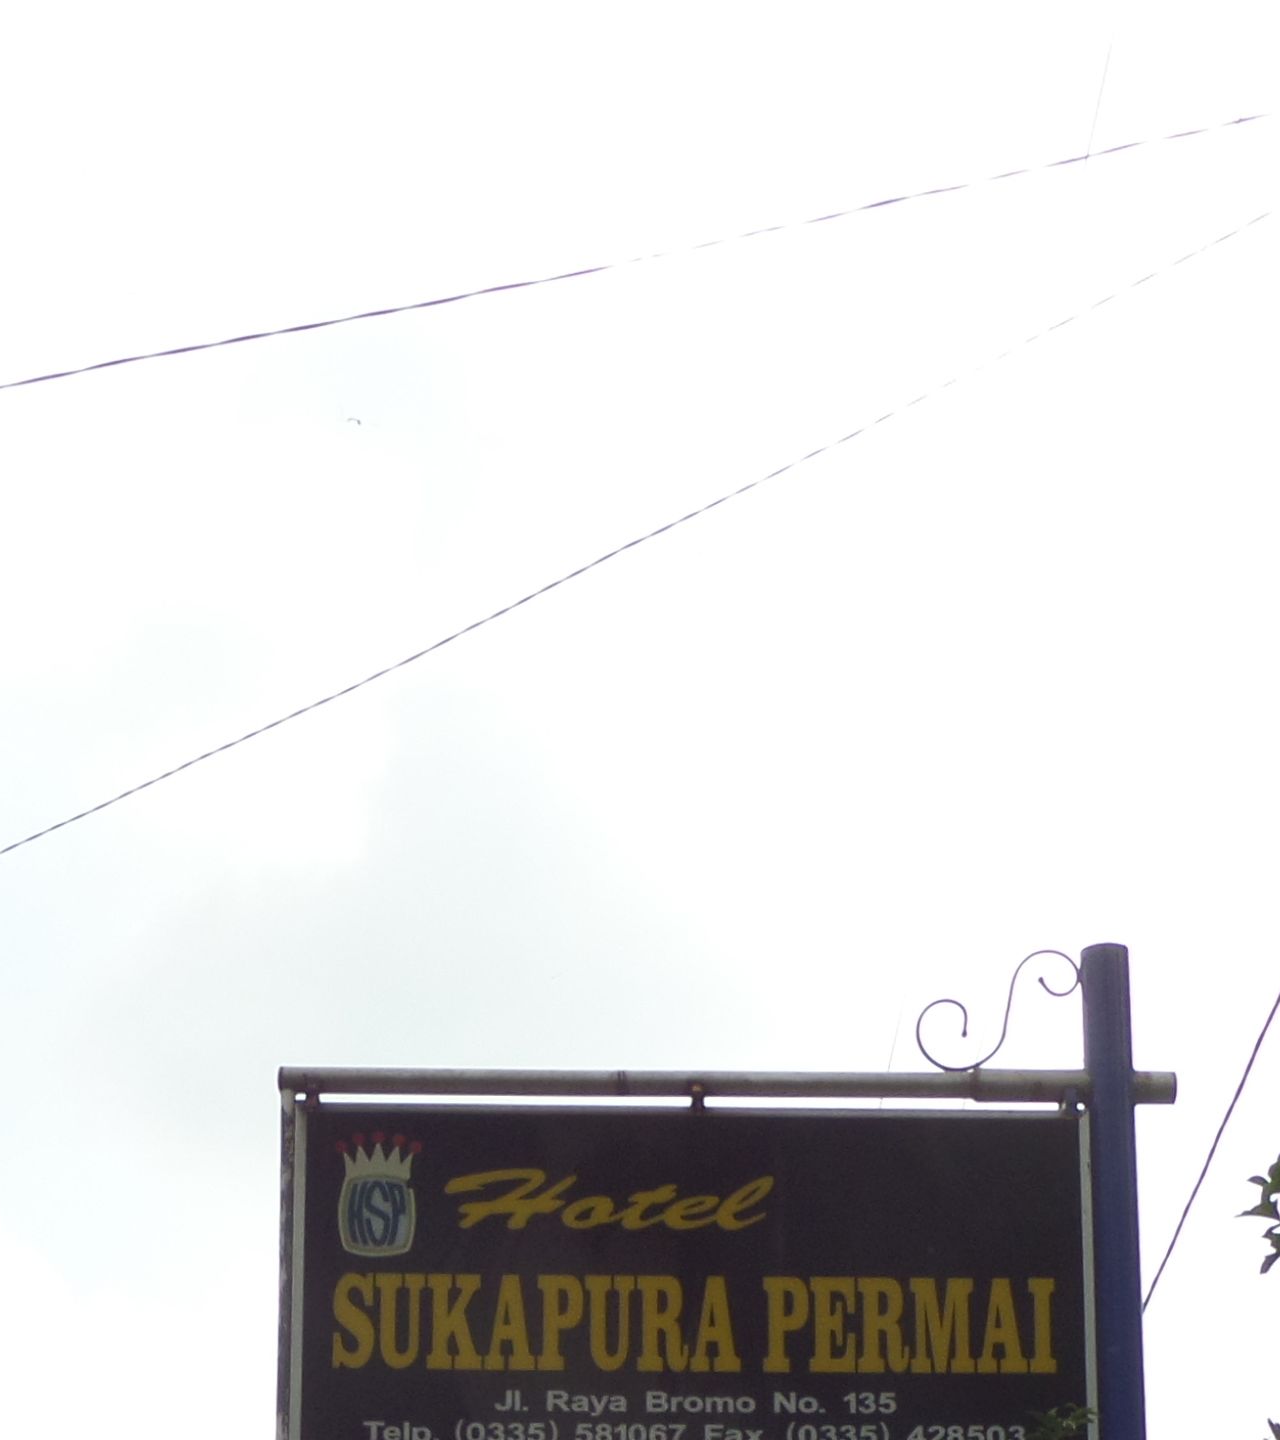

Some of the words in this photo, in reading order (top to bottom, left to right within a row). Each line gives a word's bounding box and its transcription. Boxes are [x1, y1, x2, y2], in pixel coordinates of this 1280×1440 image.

[444, 1167, 775, 1232] Hotel
[332, 1273, 742, 1372] SUKAPURA
[762, 1276, 1057, 1374] PERMAI
[494, 1391, 529, 1413] Jl.
[546, 1391, 627, 1417] Raya
[646, 1391, 756, 1414] Bromo
[774, 1392, 826, 1414] No.
[843, 1392, 896, 1414] 135
